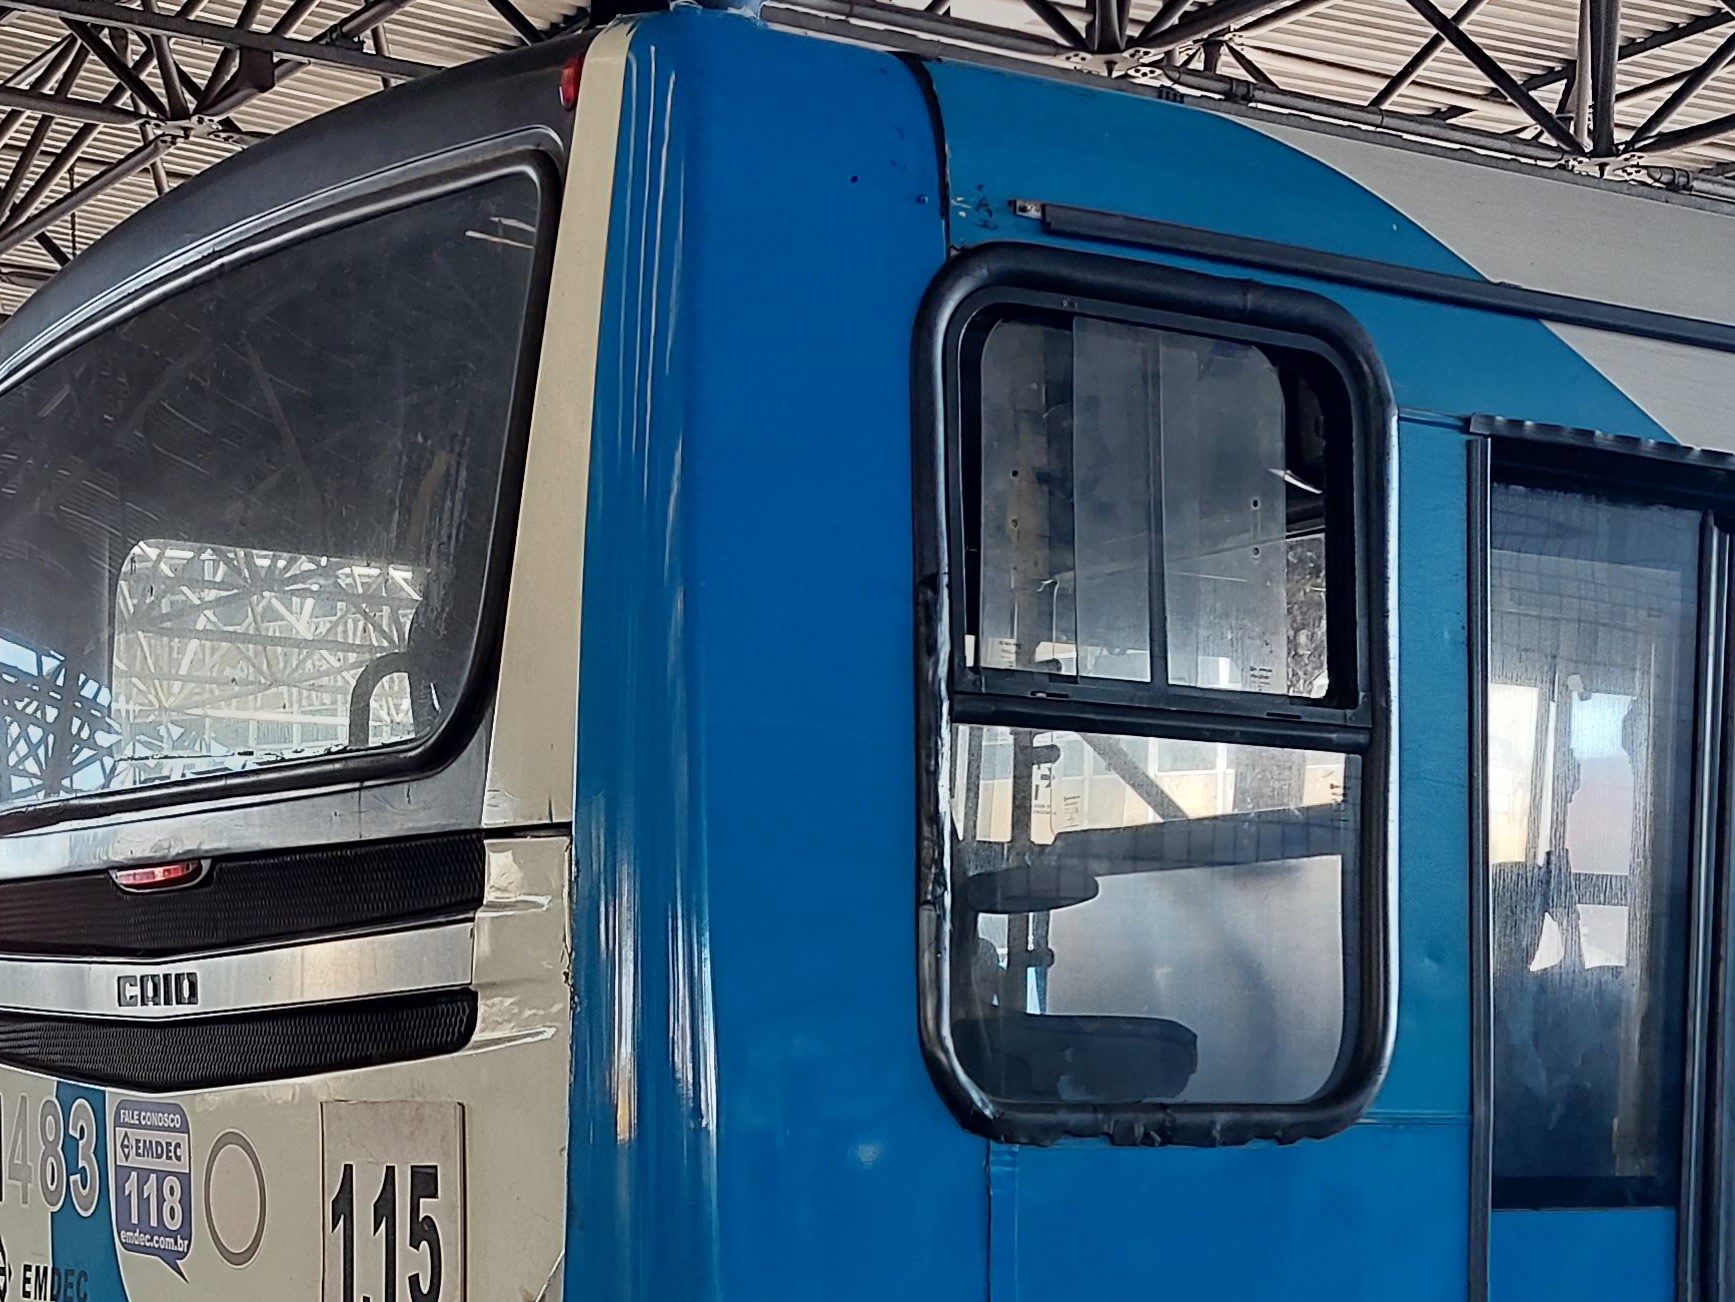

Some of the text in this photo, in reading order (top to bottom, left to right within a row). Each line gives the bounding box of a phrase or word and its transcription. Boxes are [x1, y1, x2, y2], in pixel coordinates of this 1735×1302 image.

[117, 972, 199, 1008] CAIO
[120, 1109, 181, 1128] FALE CONOSCO
[134, 1138, 182, 1162] EMDEC
[124, 1171, 183, 1230] 118
[120, 1229, 189, 1253] emdec.com.br
